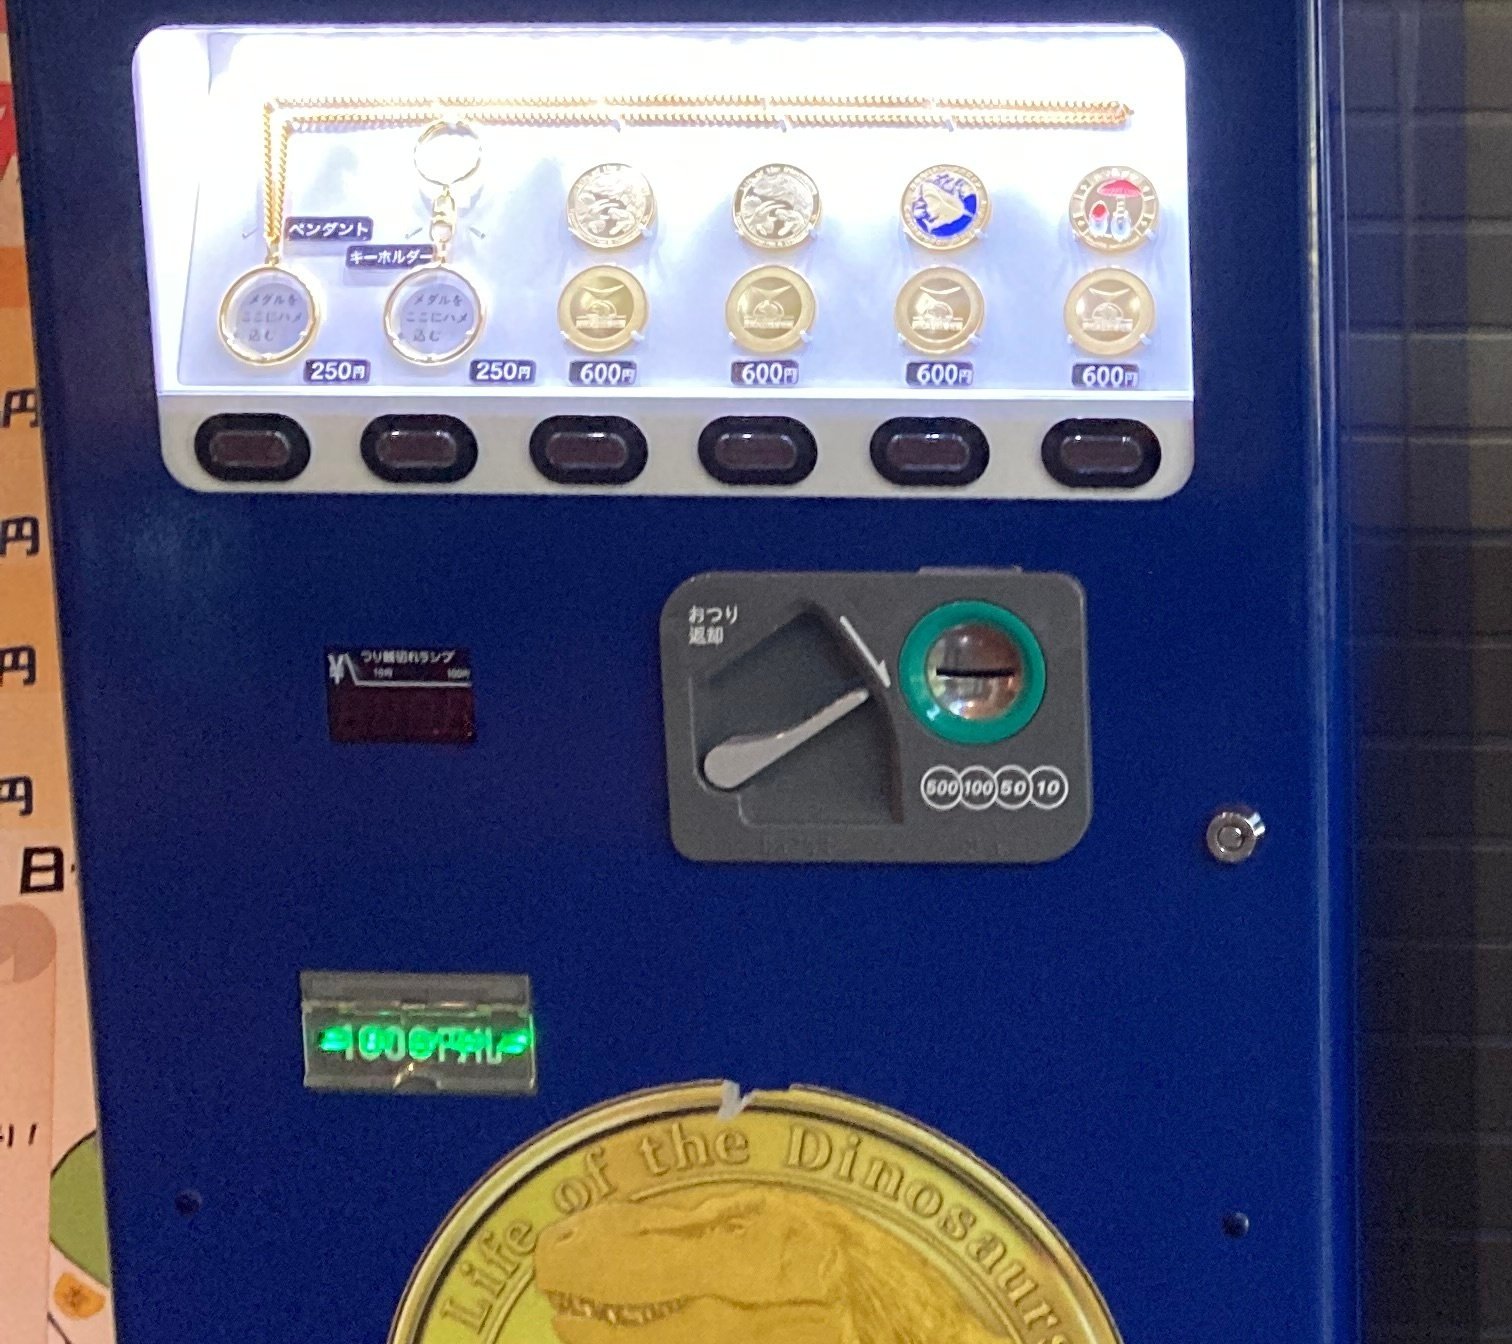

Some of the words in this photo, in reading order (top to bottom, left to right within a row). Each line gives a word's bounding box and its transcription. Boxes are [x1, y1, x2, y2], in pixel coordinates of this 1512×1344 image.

[288, 221, 369, 239] ペンダント
[350, 250, 432, 265] キーホルダー
[311, 362, 366, 380] 250円
[476, 362, 531, 381] 250円
[579, 362, 636, 384] 600円
[741, 364, 798, 384] 600円
[916, 364, 973, 385] 600円
[1081, 366, 1139, 387] 600円
[688, 606, 739, 624] おつり
[688, 626, 724, 646] 返却
[926, 778, 959, 797] 500
[963, 778, 993, 797] 100
[1000, 778, 1027, 797] 50
[1037, 778, 1059, 797] 10
[439, 1217, 538, 1337] Life
[551, 1151, 618, 1212] of
[640, 1123, 750, 1177] the
